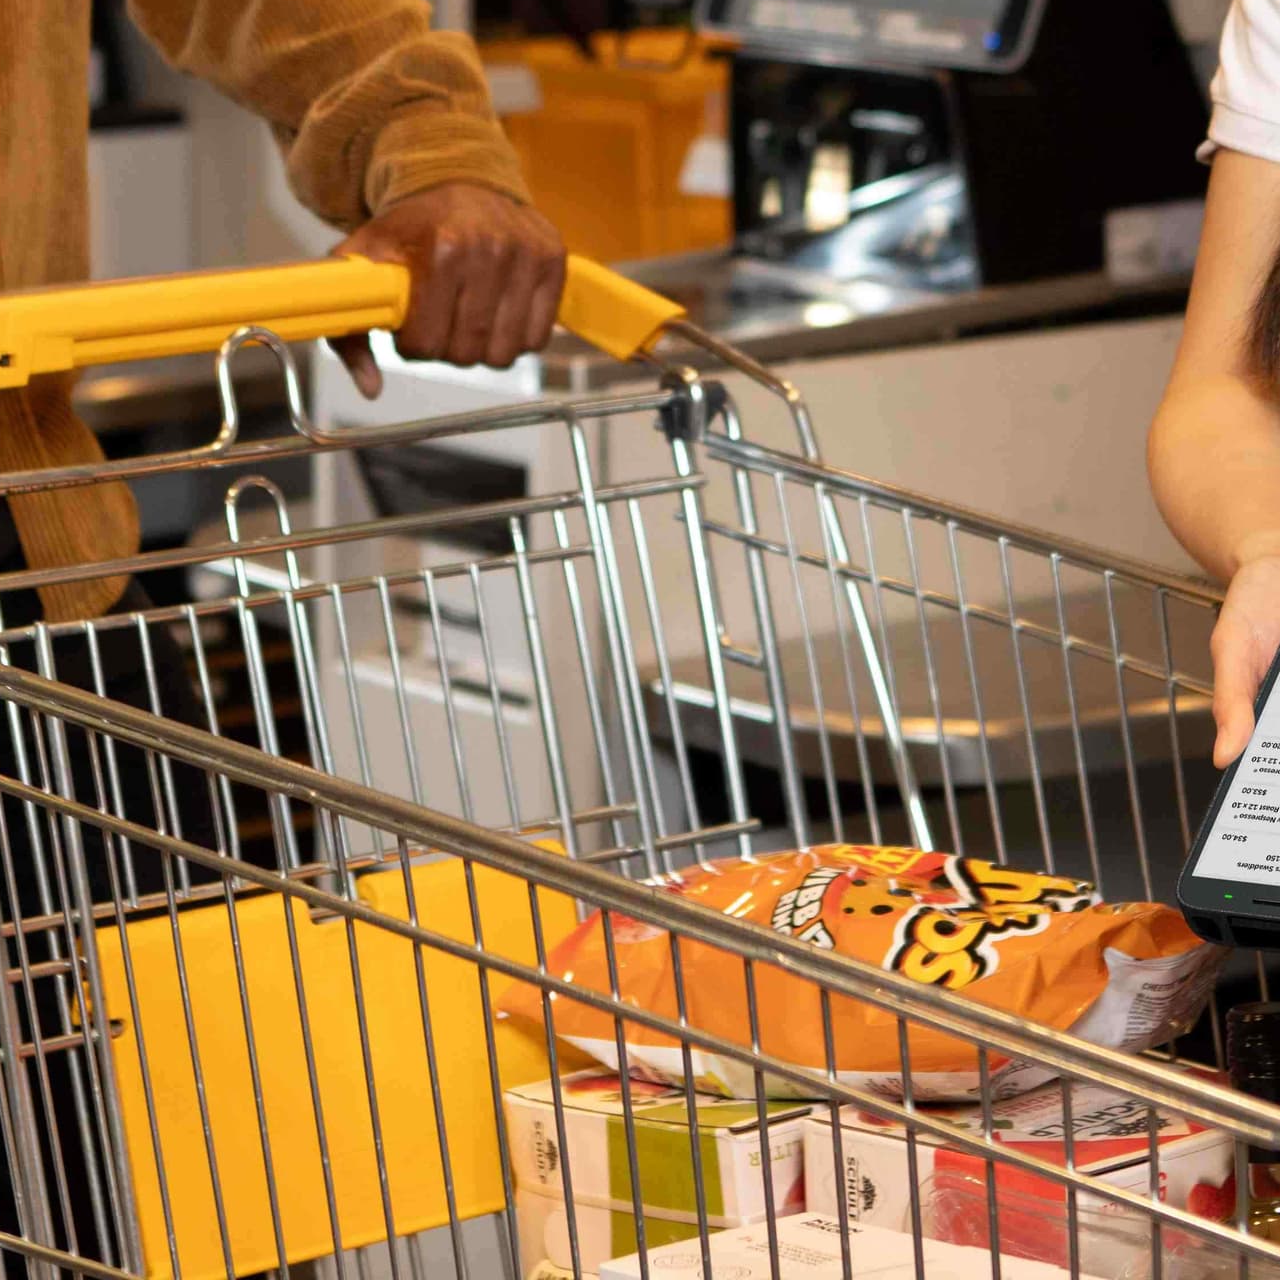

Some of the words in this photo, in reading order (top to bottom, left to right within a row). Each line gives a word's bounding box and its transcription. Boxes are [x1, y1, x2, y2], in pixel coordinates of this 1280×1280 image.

[1267, 757, 1278, 765] 12
[1241, 787, 1268, 796] $53.00
[1231, 801, 1243, 809] 10
[1247, 803, 1259, 811] 12
[1258, 804, 1280, 813] Roast
[1239, 813, 1277, 824] Nespresso
[1221, 833, 1248, 843] $34.00
[1265, 854, 1280, 862] 150
